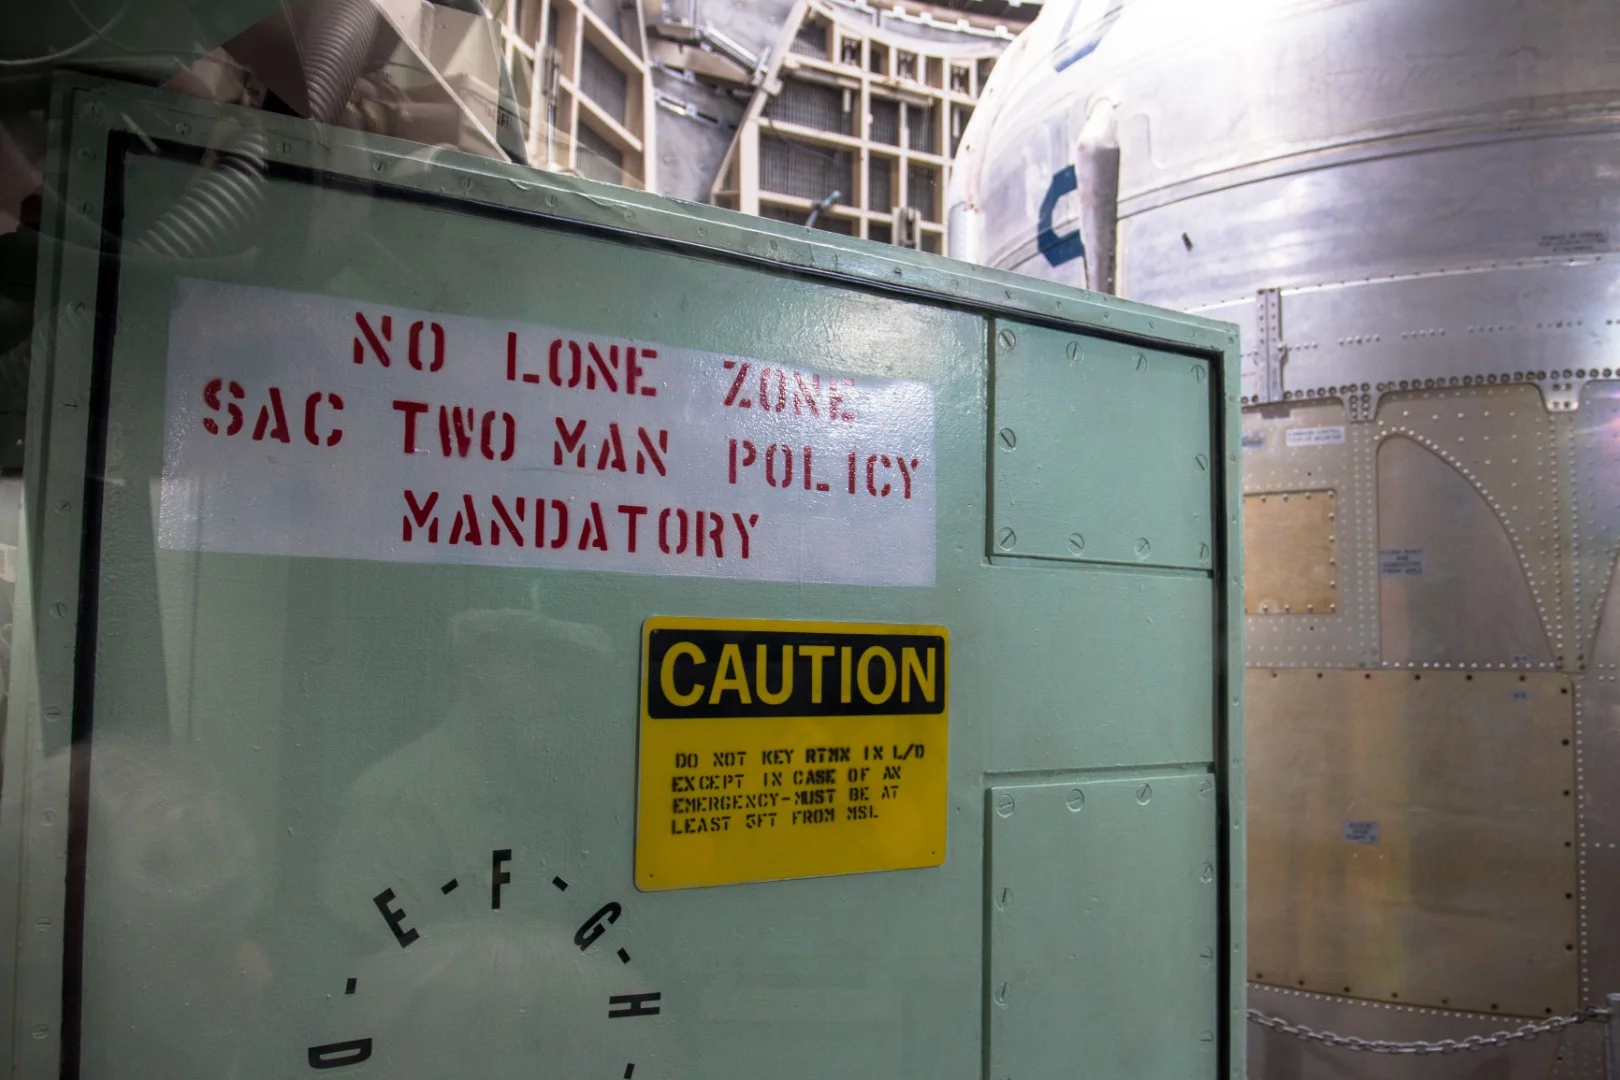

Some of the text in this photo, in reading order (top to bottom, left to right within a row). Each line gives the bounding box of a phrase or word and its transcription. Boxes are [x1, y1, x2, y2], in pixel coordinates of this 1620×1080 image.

[355, 313, 856, 422] NO LONE ZONE
[203, 379, 919, 500] SAC TWO MAN POLICY
[402, 489, 759, 559] MANDATORY
[660, 641, 936, 707] CAUTION
[671, 765, 901, 793] EXCEPT IN CASE OF AN
[674, 752, 699, 768] DO
[713, 751, 747, 767] NOT
[761, 749, 795, 765] KEY
[863, 745, 883, 761] IN
[892, 743, 925, 760] L/D
[671, 815, 731, 835] LEAST
[745, 812, 777, 829] 5FT
[791, 807, 835, 825] FROM
[849, 786, 869, 802] BE
[881, 785, 899, 799] AT
[308, 848, 662, 1070] D E F G H
